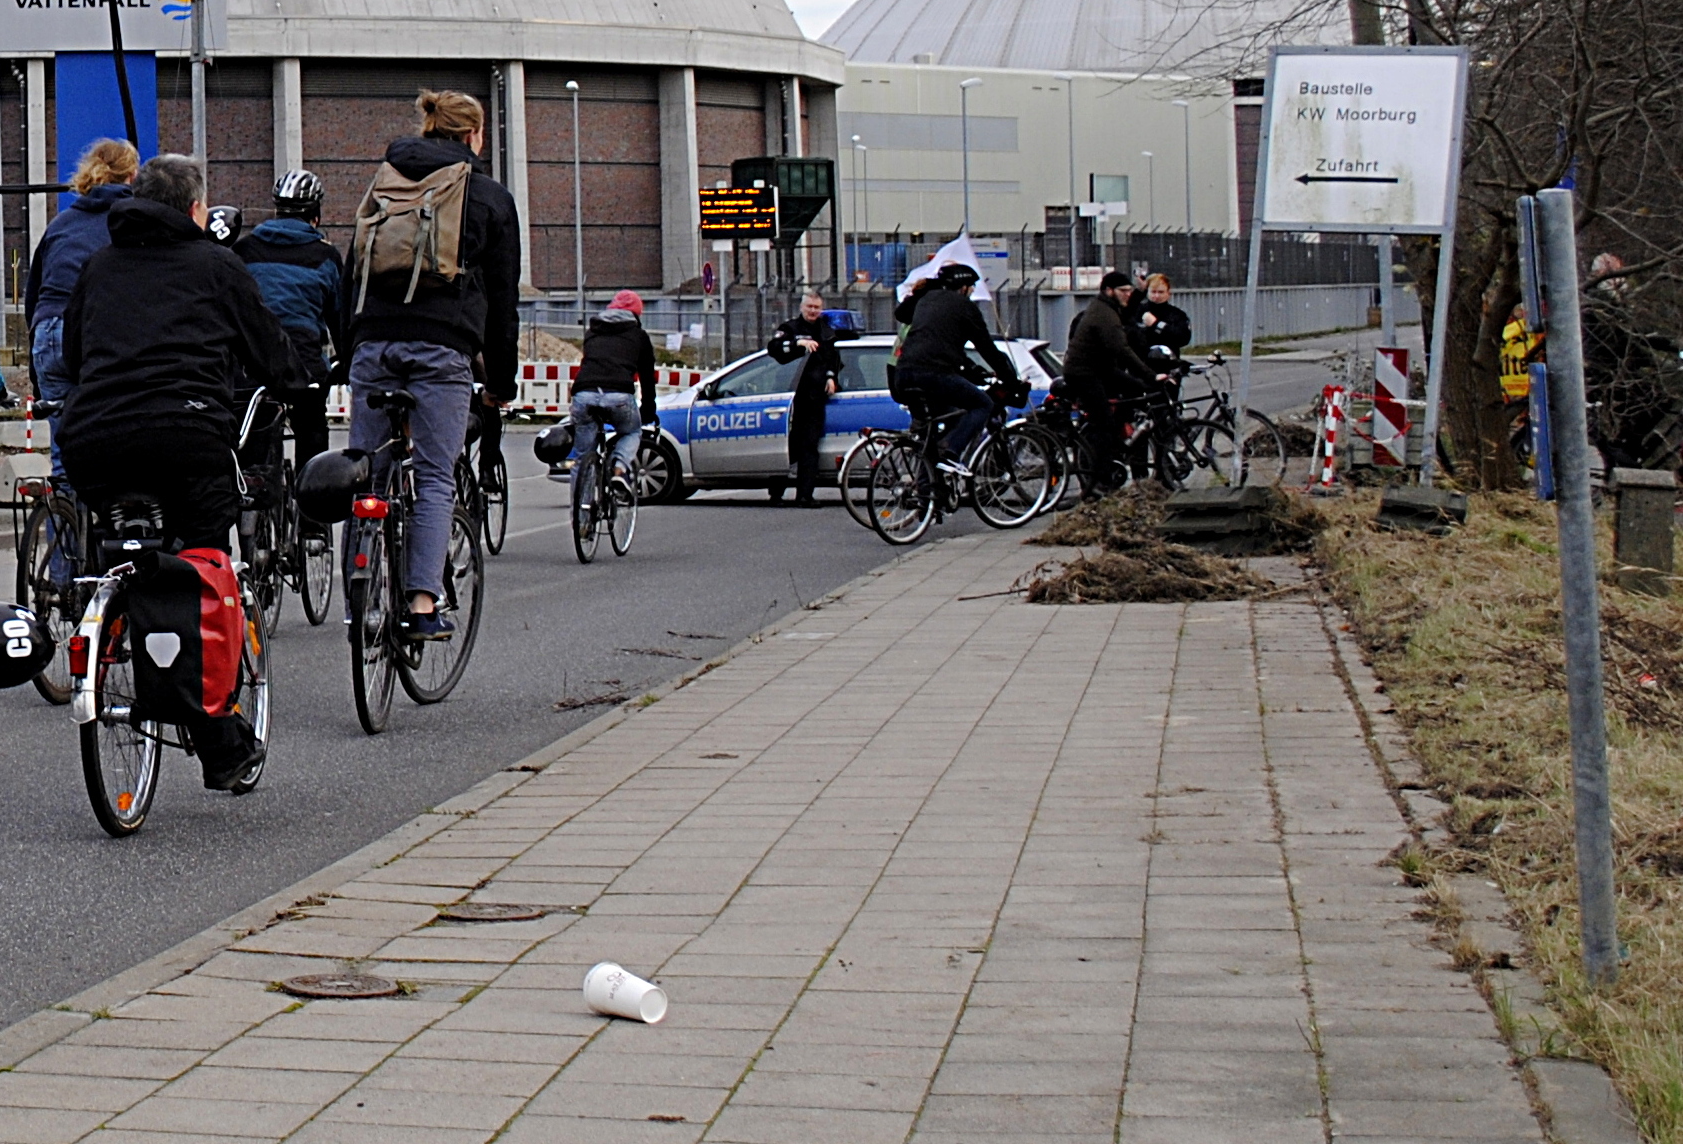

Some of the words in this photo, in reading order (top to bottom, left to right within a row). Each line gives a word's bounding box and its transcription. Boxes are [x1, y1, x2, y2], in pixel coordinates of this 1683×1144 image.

[1299, 81, 1373, 96] Baustelle
[1297, 107, 1326, 121] KW
[1336, 107, 1417, 125] Moorburg
[1316, 158, 1379, 173] Zufahrt
[697, 411, 761, 431] POLIZEI
[2, 608, 36, 658] CO2
